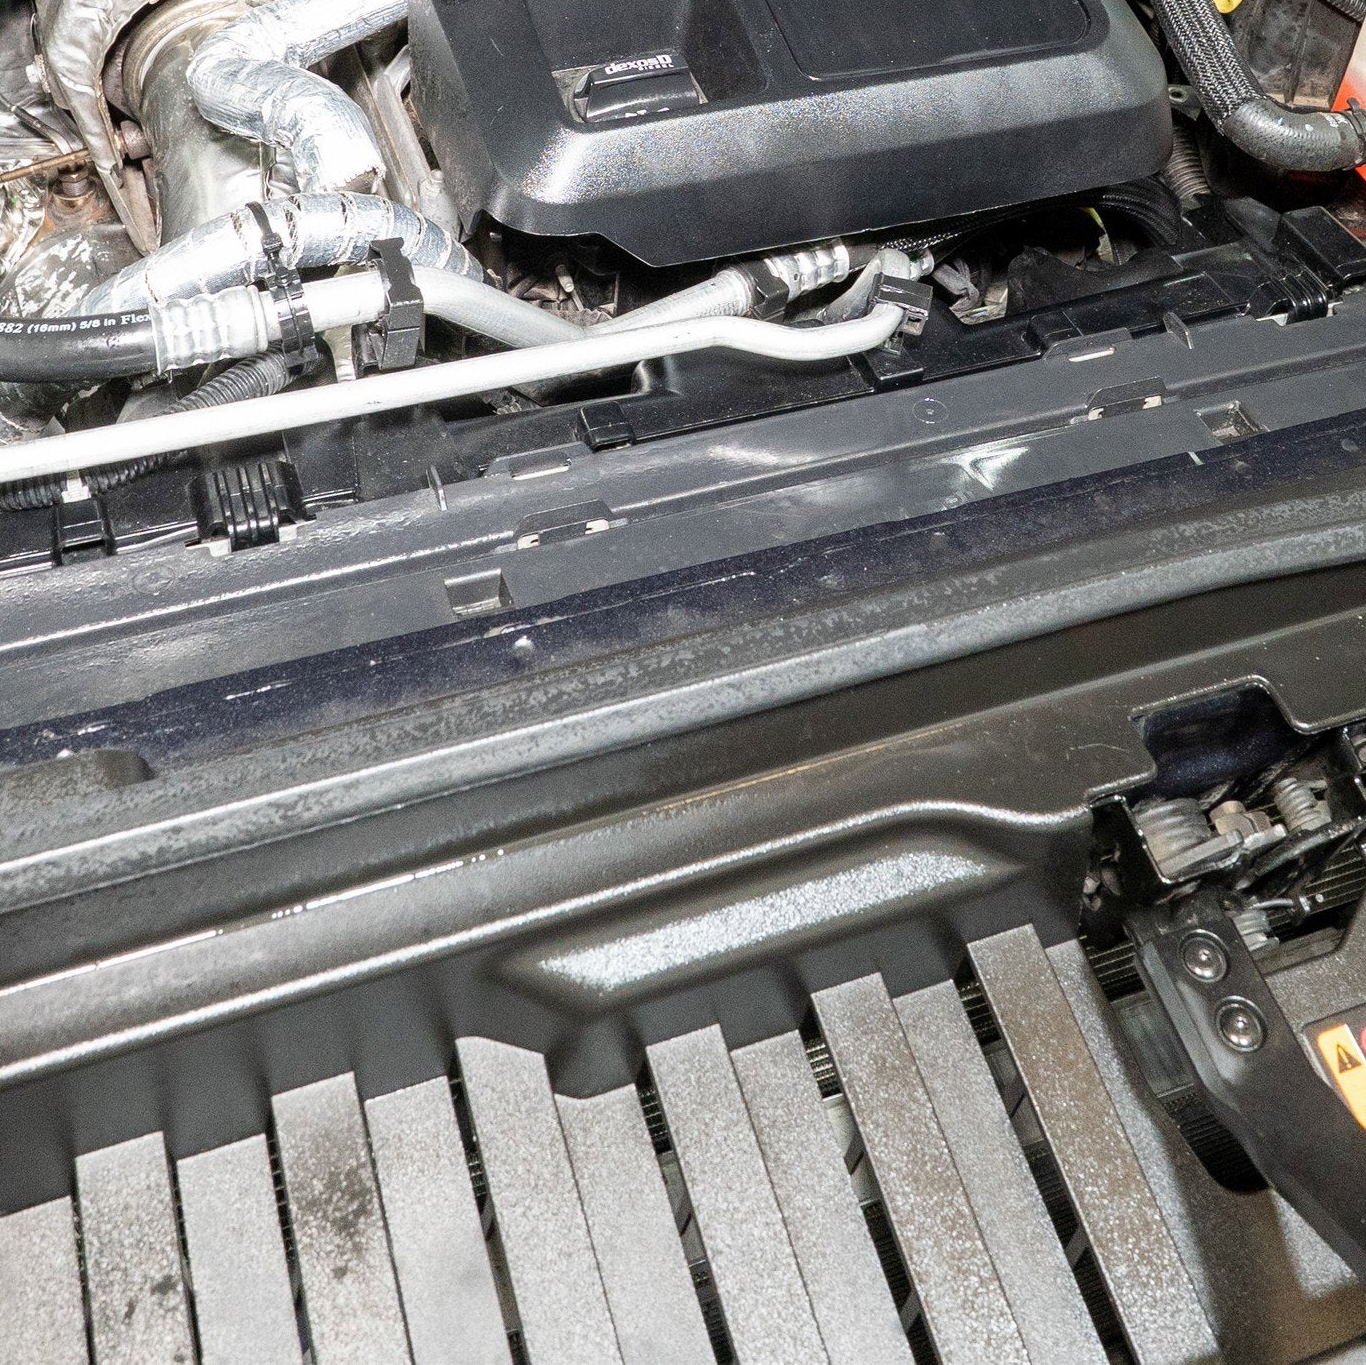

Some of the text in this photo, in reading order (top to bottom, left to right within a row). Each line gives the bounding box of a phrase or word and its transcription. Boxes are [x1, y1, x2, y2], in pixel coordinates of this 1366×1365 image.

[27, 321, 76, 334] (16mm)
[79, 319, 101, 329] 5/8
[104, 318, 116, 327] in
